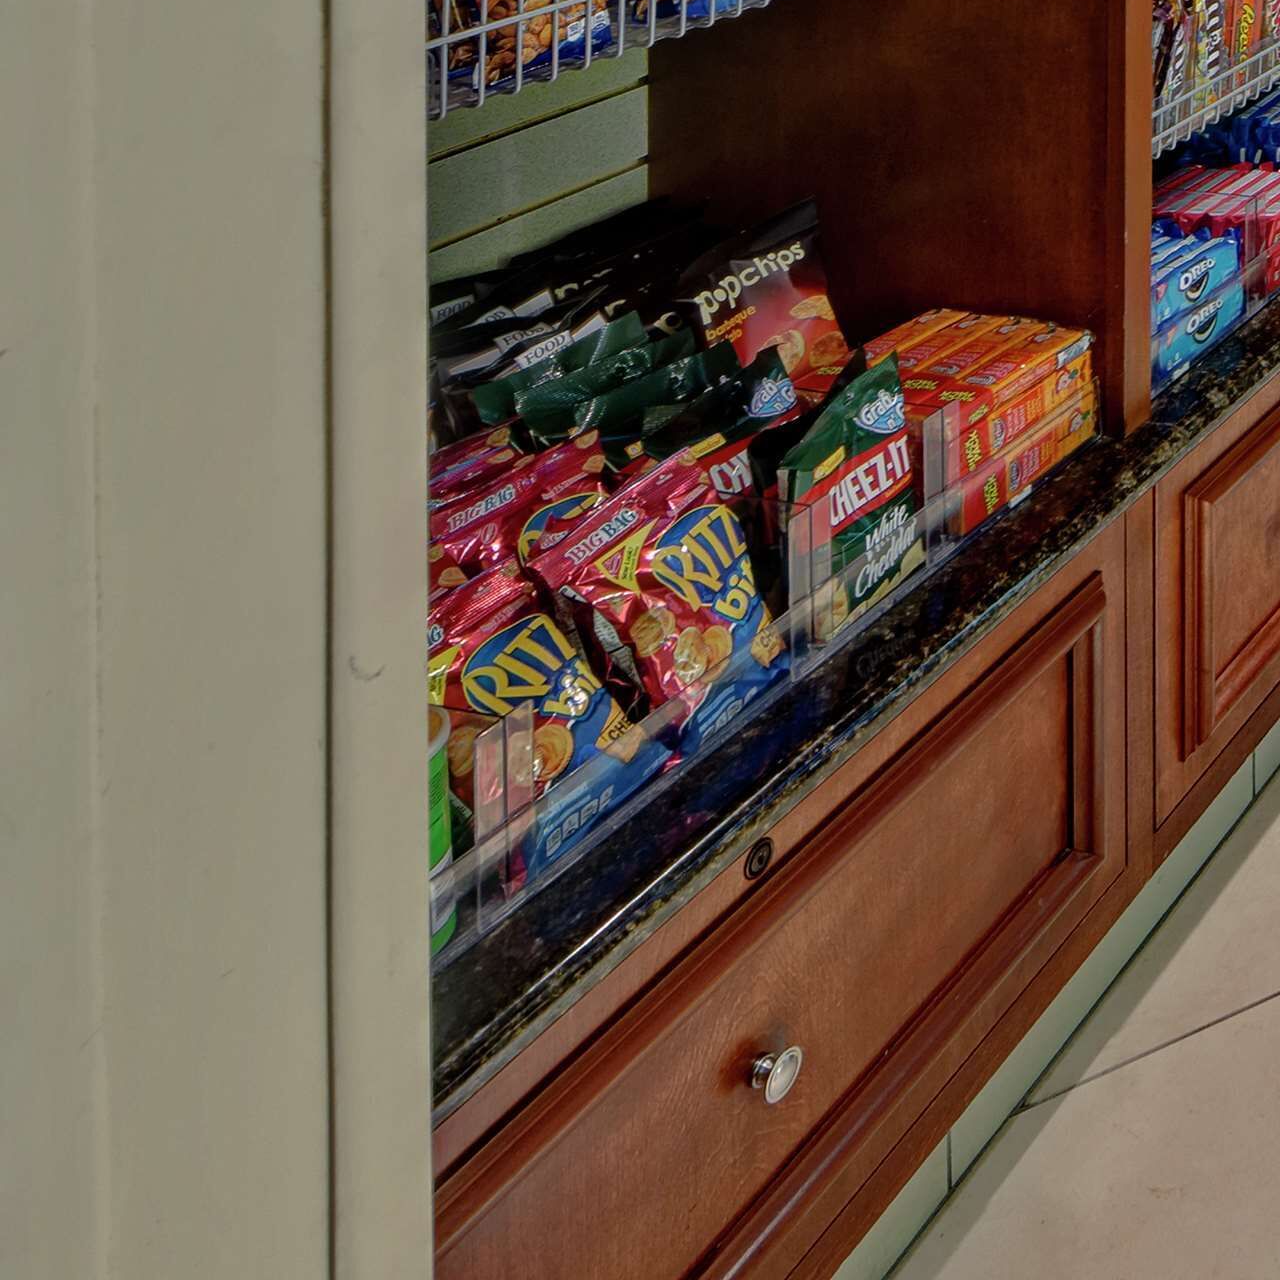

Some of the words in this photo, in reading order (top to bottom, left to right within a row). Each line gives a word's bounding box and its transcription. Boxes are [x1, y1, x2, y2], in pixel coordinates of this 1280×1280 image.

[694, 241, 806, 326] popchips
[1179, 258, 1216, 292] OREO
[1186, 298, 1224, 335] OREO
[523, 335, 566, 365] FOOD
[860, 388, 897, 425] Grab
[447, 503, 482, 533] BIG
[483, 484, 516, 513] BAG
[829, 435, 911, 528] CHEEZ-IT
[565, 533, 603, 566] BIG
[601, 507, 639, 540] BAG
[865, 503, 909, 551] White
[652, 505, 747, 612] RITZ
[855, 516, 918, 599] Cheddar
[461, 614, 578, 717] RITZ
